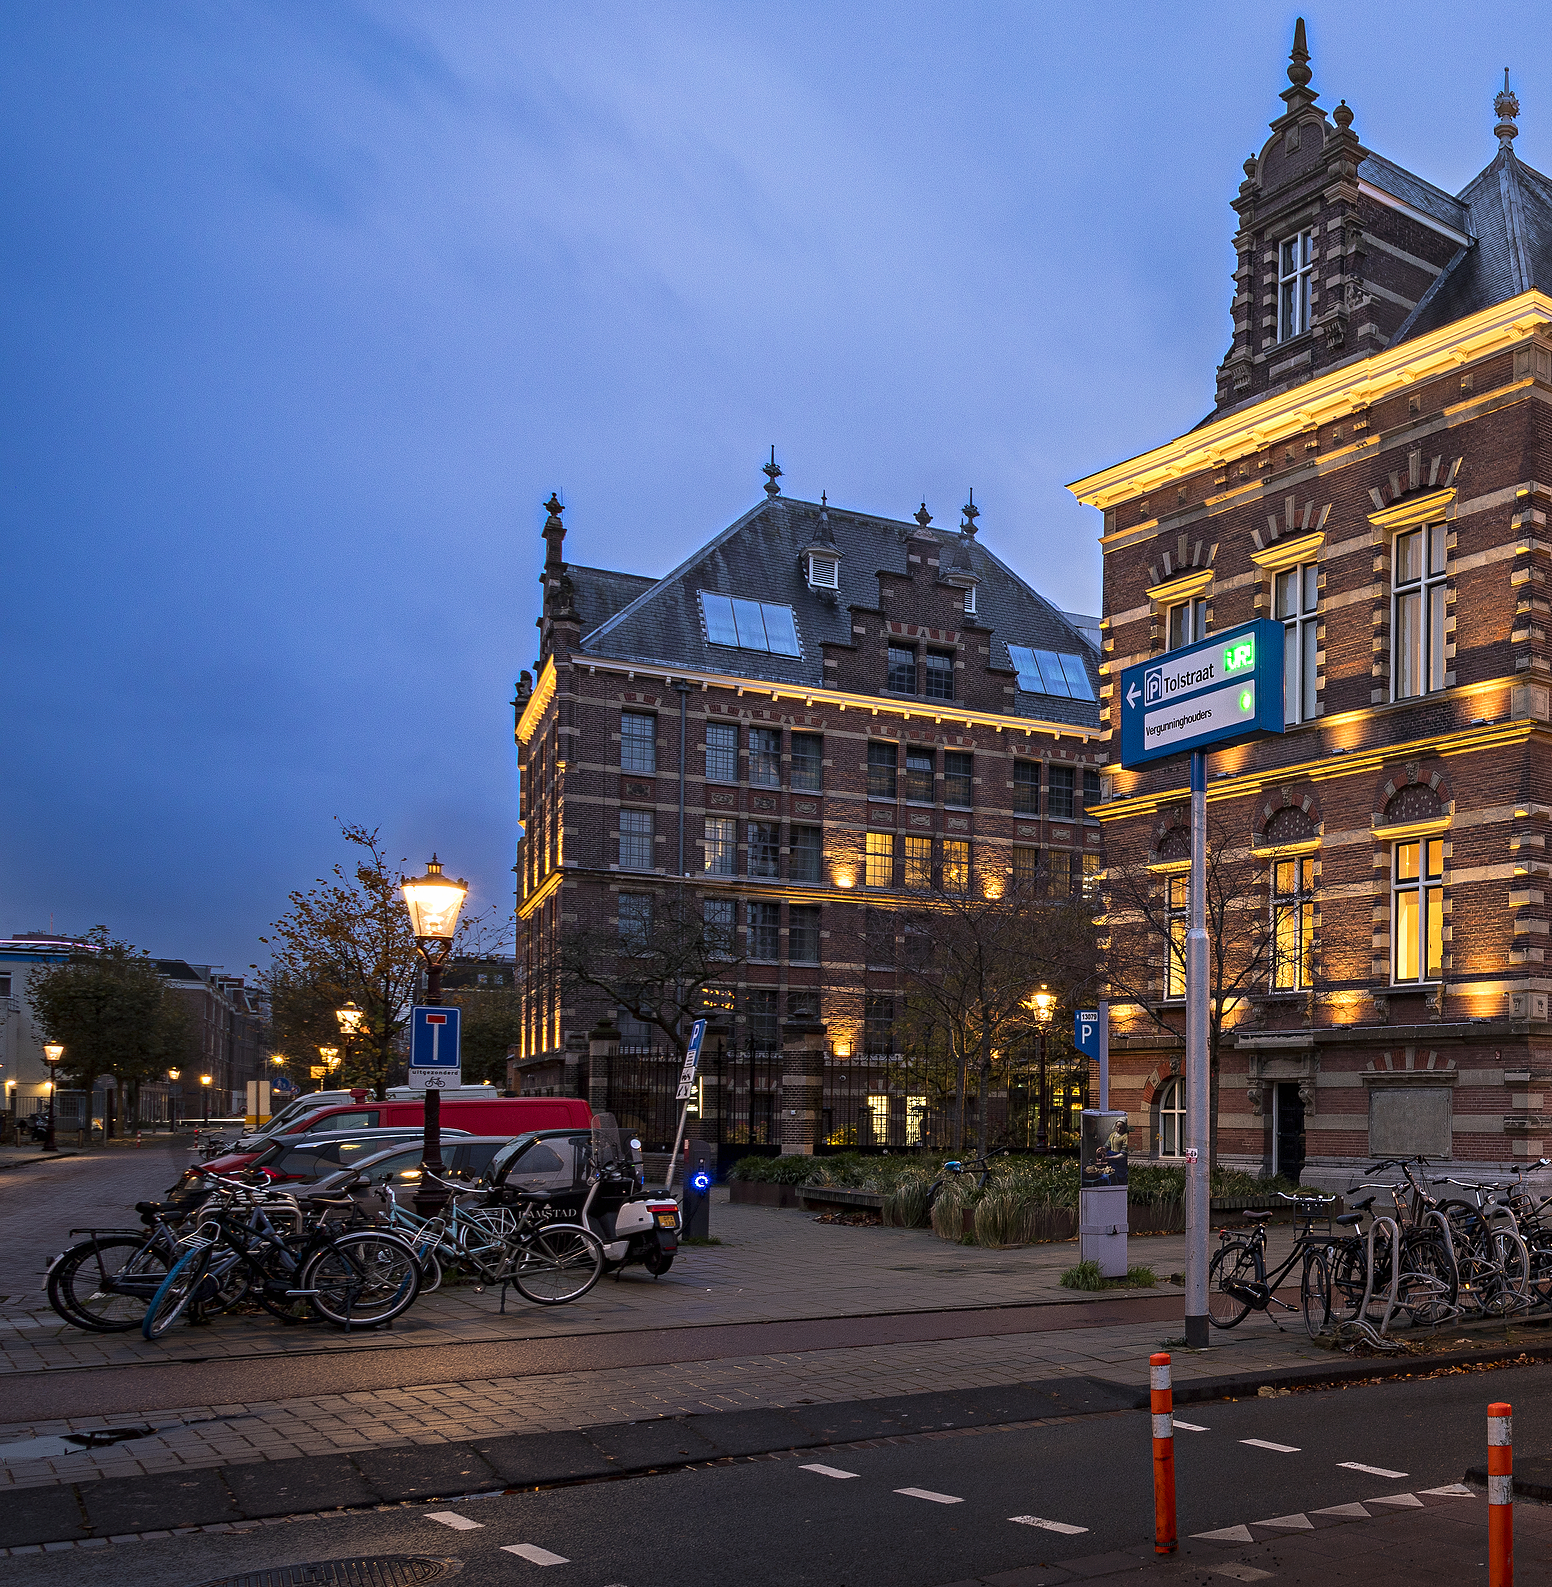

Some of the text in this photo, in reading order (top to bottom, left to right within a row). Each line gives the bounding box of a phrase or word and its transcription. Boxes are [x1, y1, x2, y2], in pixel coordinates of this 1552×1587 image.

[1164, 663, 1215, 694] Tolstraat
[1145, 708, 1213, 737] Vergunninghouders
[1081, 1024, 1093, 1044] P
